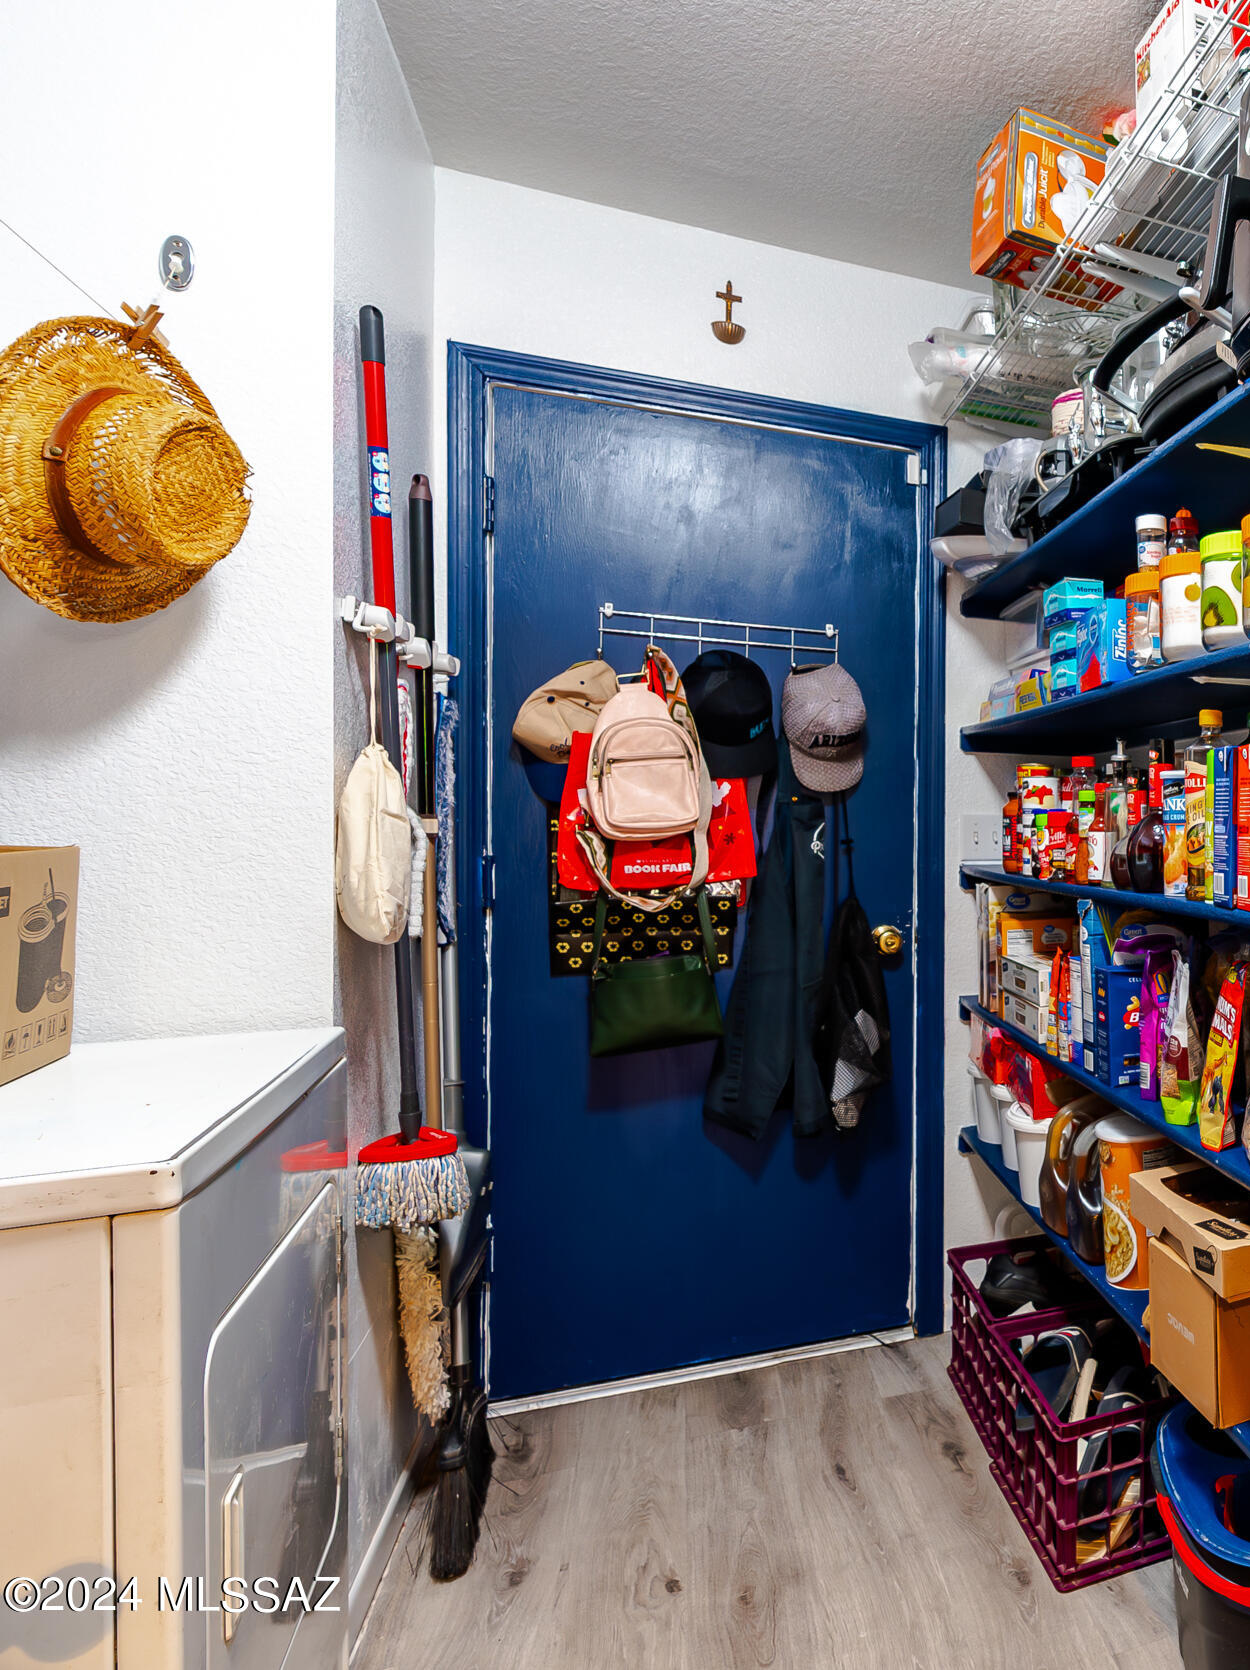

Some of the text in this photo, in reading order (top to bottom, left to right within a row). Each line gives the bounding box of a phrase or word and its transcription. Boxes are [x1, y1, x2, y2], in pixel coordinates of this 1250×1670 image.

[1163, 798, 1186, 811] ANK
[624, 862, 692, 874] BOOK FAIR
